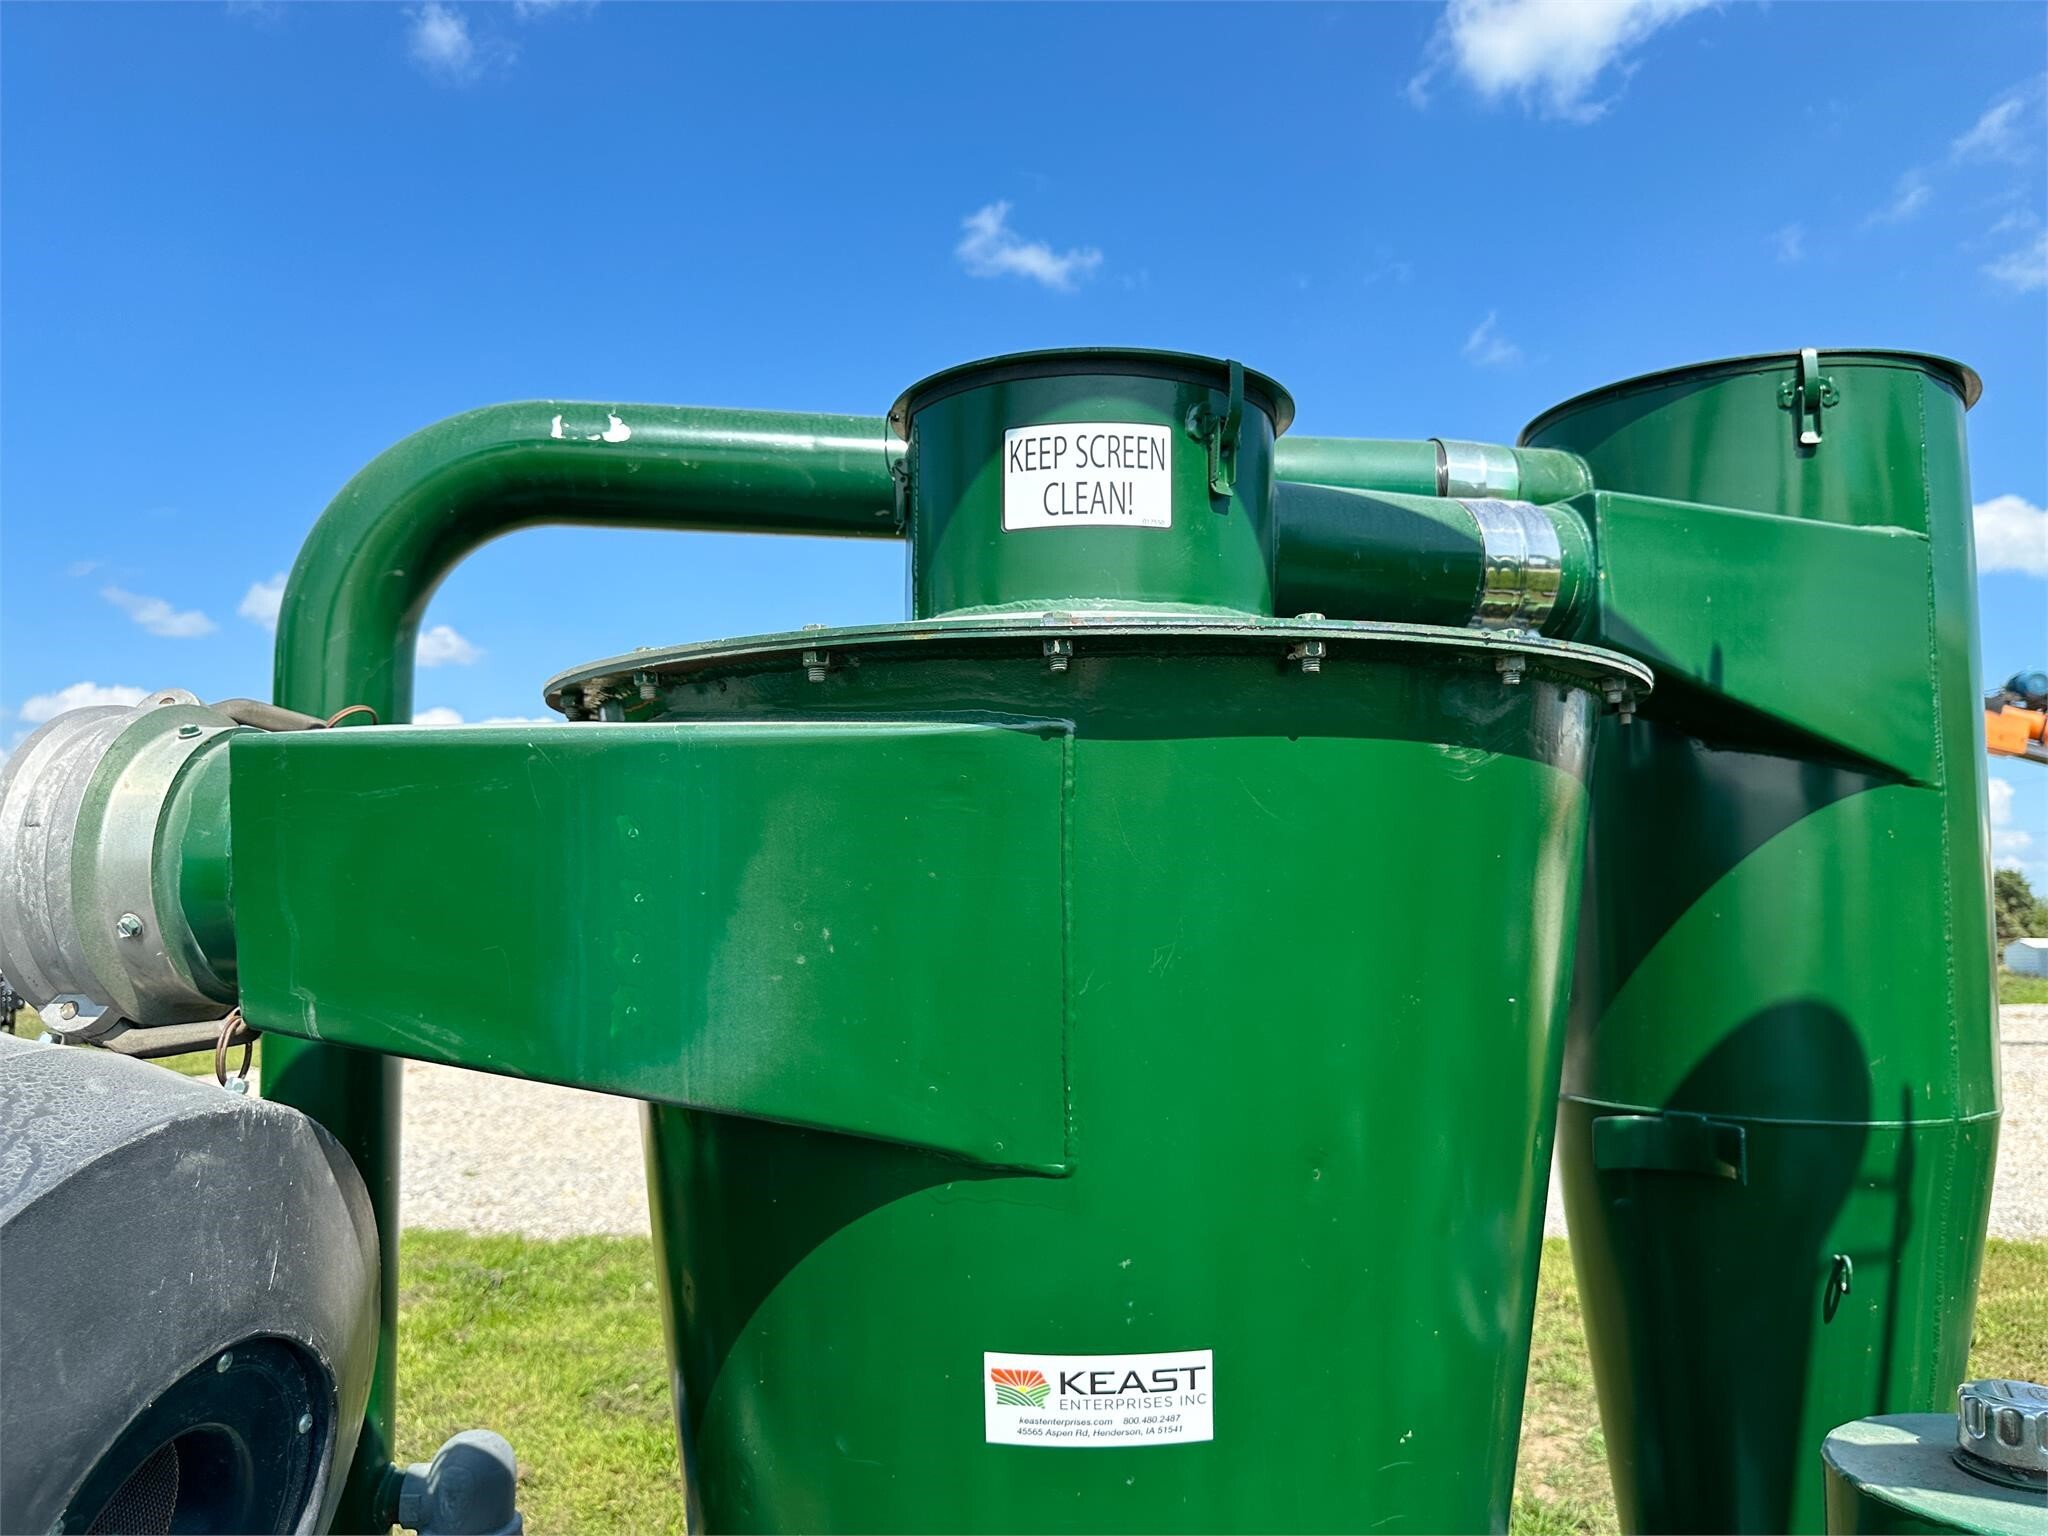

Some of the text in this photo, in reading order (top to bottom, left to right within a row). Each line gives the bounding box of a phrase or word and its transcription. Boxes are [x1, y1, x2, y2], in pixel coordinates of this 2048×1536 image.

[1010, 434, 1165, 473] KEEP SCREEN
[1043, 481, 1133, 516] CLEAN!
[1059, 1365, 1206, 1395] KEAST
[1059, 1393, 1208, 1411] ENTERPRISES INC
[1016, 1425, 1183, 1438] 45565 Aspen Rd, Henderson, IA 51541
[1019, 1414, 1181, 1427] keastenterprises.com 800.480.2487
